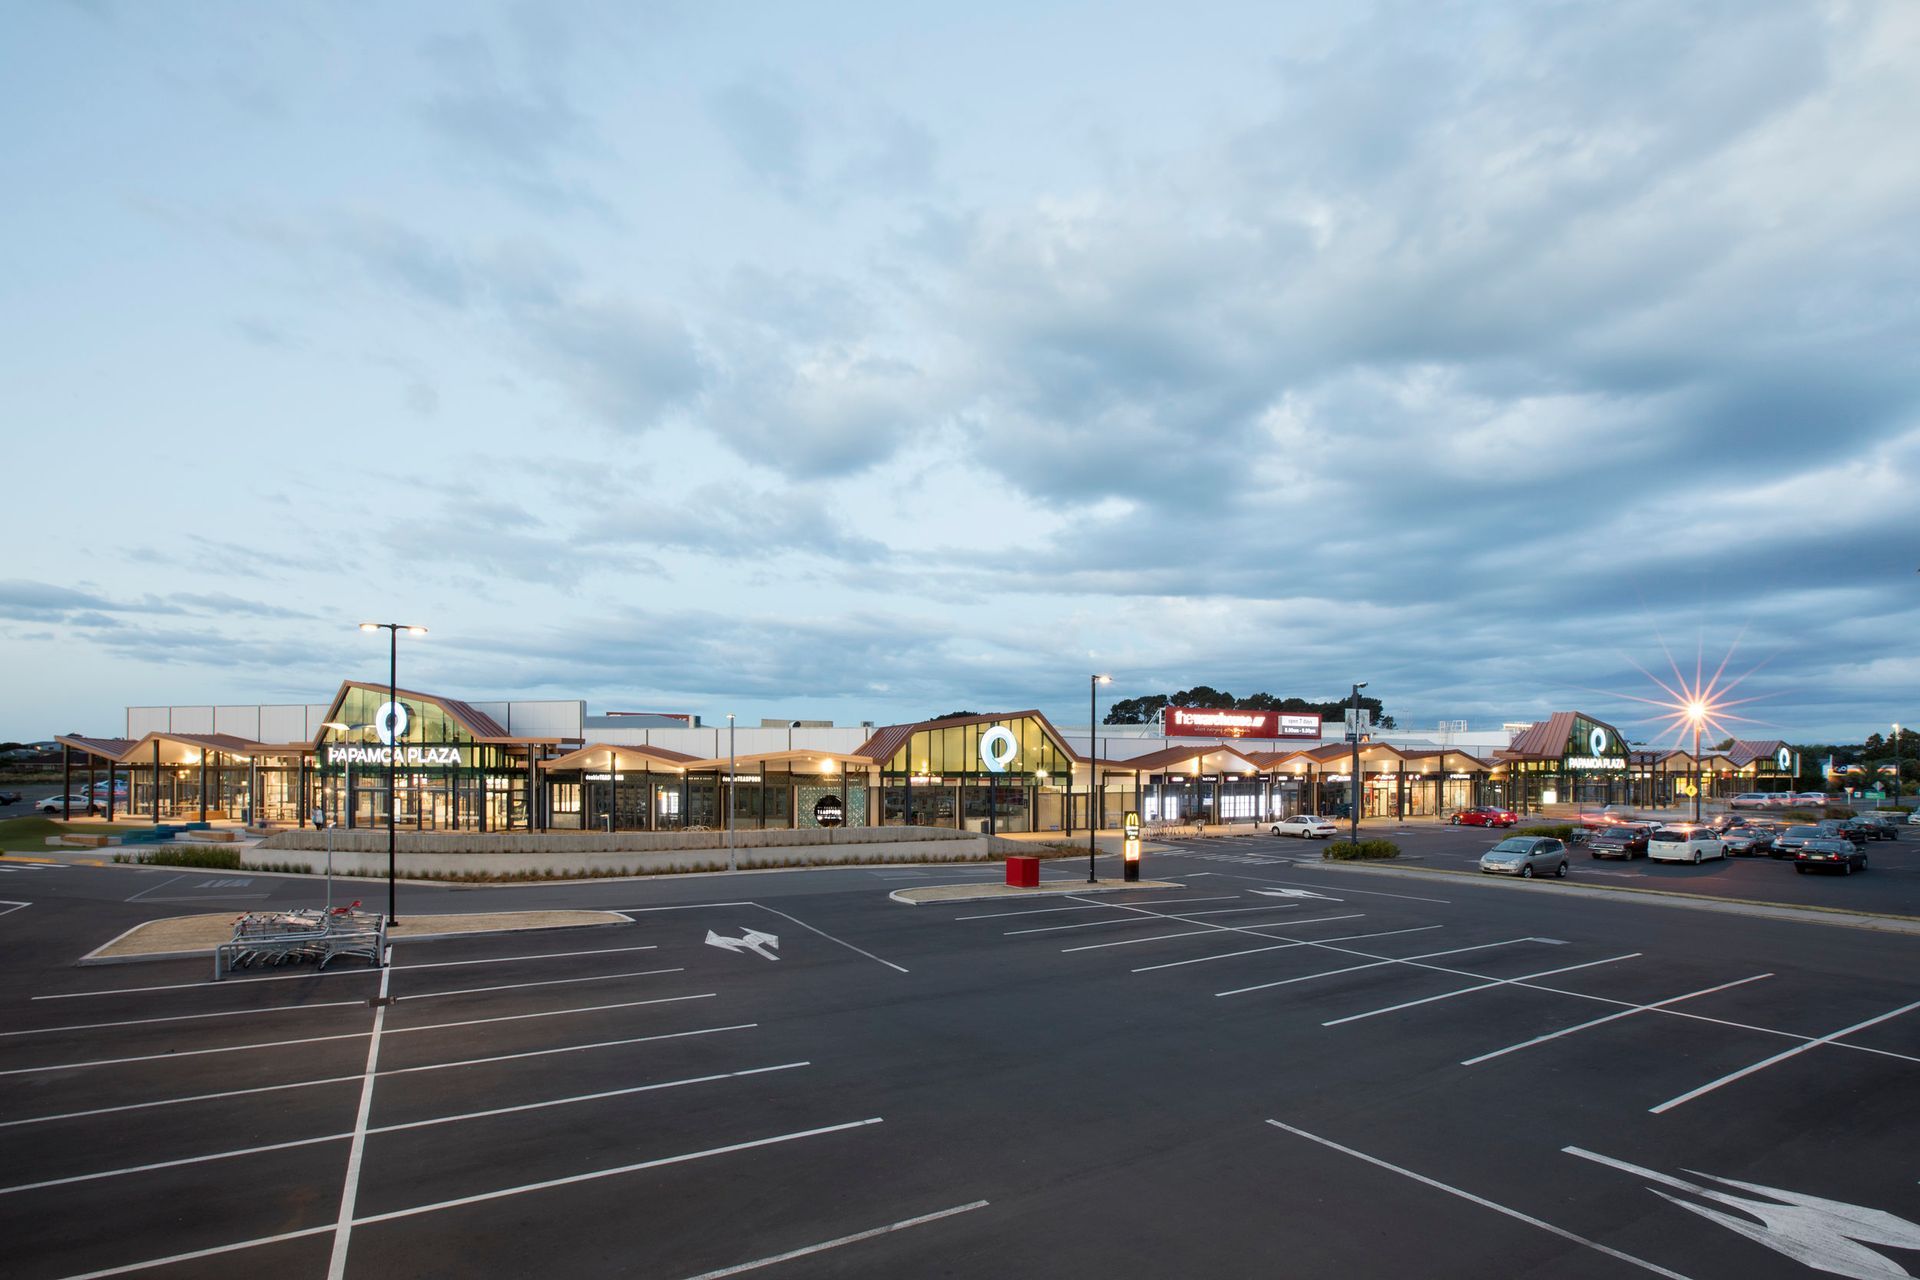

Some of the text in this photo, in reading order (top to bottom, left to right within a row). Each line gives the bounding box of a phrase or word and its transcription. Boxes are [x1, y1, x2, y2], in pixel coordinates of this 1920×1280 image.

[408, 748, 461, 765] PLAZA
[1569, 757, 1626, 769] PAPAMOA PLAZA
